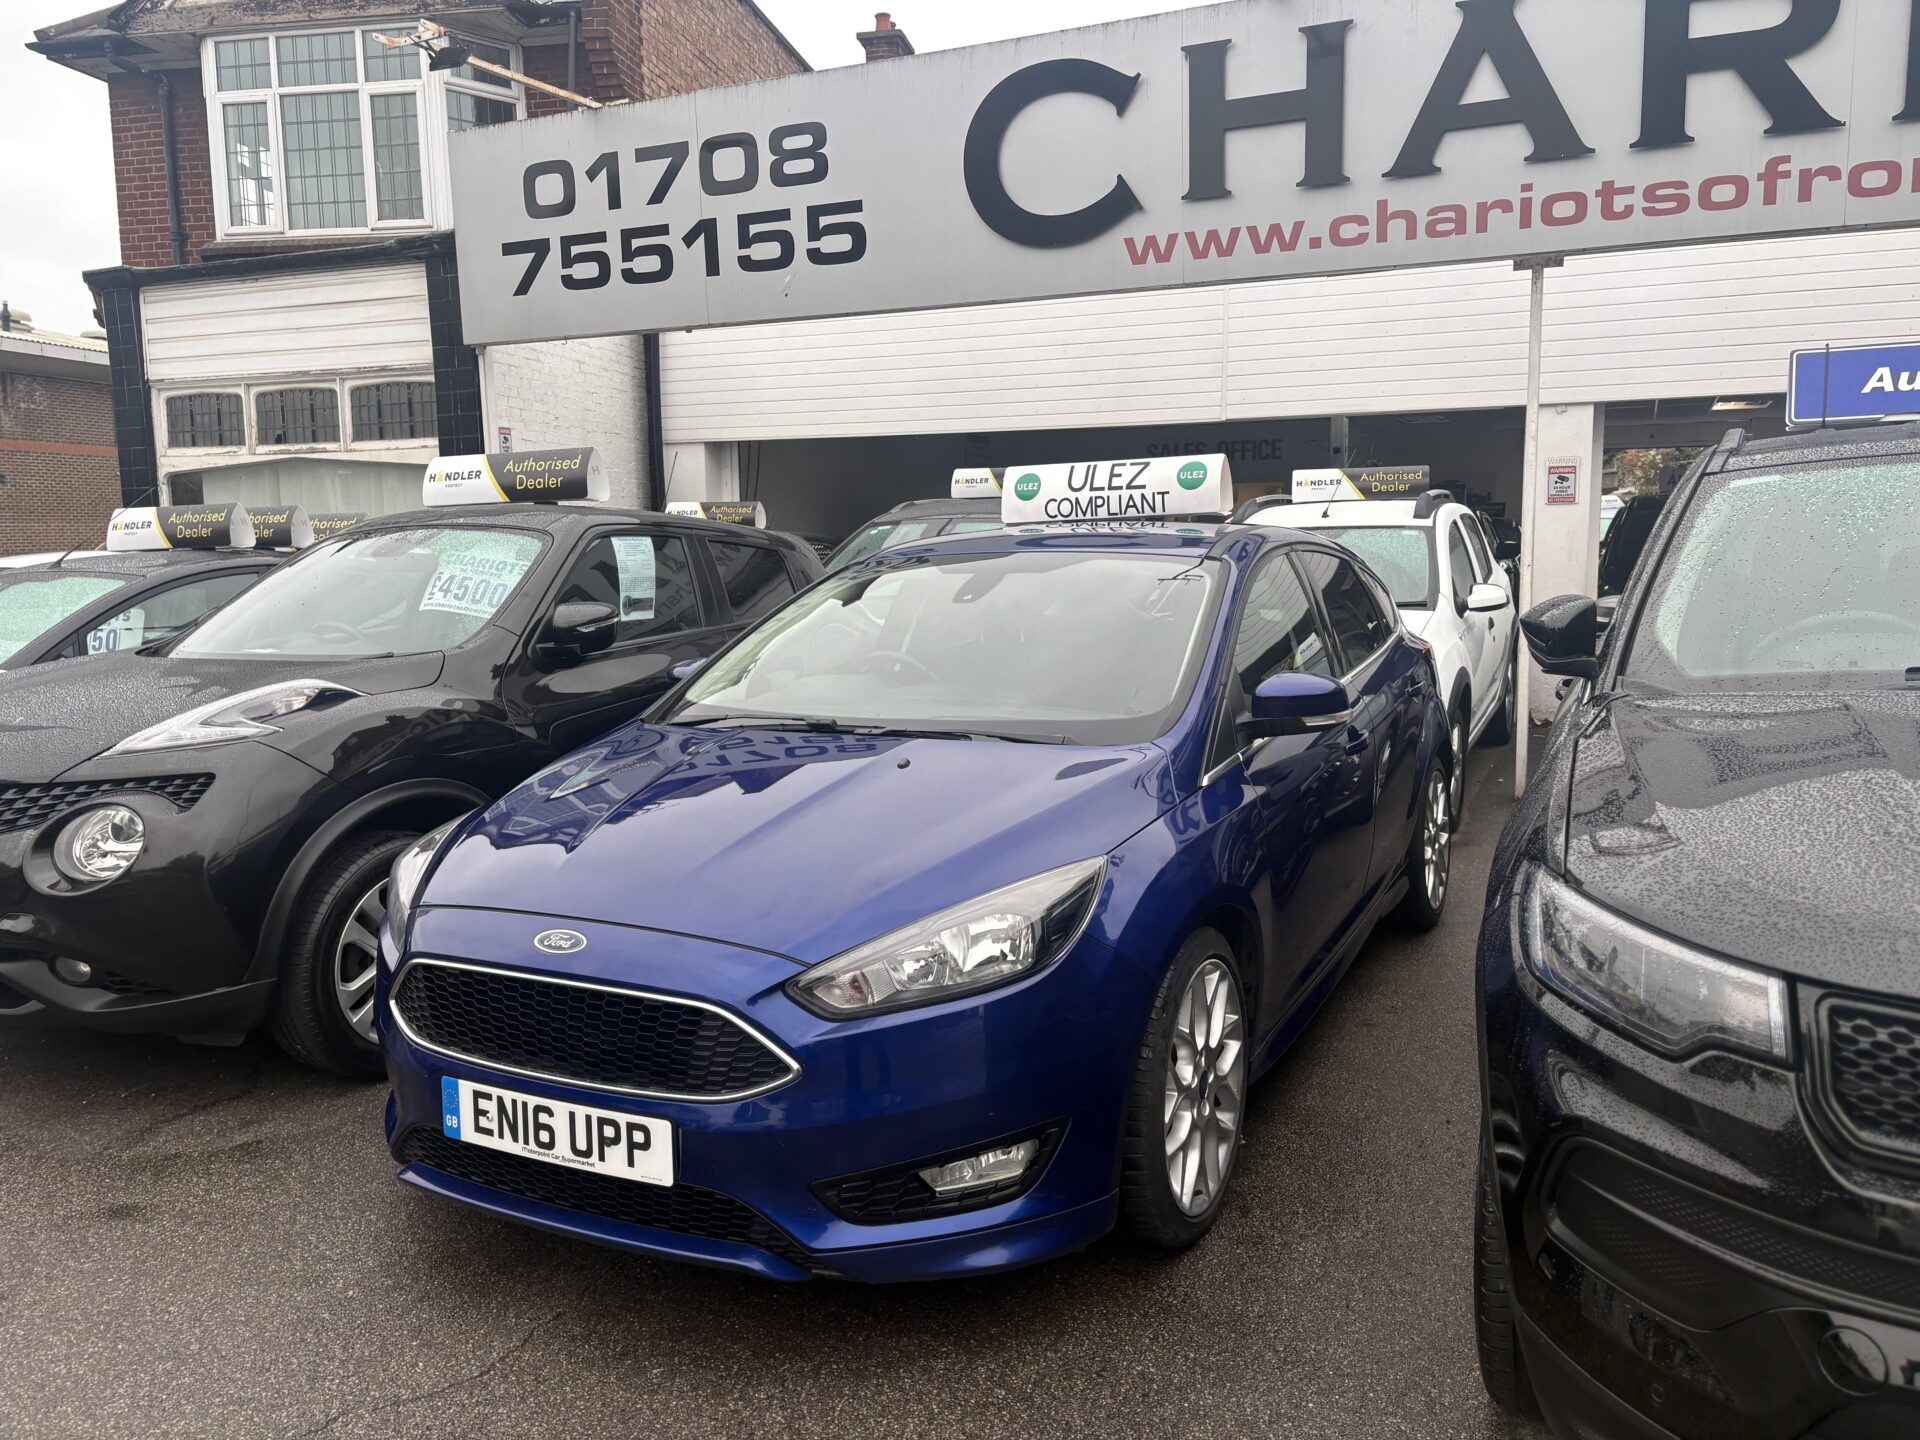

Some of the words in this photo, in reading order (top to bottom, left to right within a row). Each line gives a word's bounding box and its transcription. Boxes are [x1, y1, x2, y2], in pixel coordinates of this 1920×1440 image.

[963, 0, 1920, 249] CHAR
[522, 121, 829, 219] 01708
[1123, 155, 1920, 266] www.chariotsofro
[501, 199, 867, 297] 755155
[1217, 438, 1282, 462] OFFICE
[503, 453, 582, 473] Authorised
[516, 473, 563, 490] Dealer
[1067, 462, 1150, 492] ULEZ
[1180, 471, 1205, 479] ULEZ
[1360, 470, 1422, 481] Authorised
[1017, 483, 1039, 491] ULEZ
[1371, 482, 1411, 492] Dealer
[710, 505, 752, 514] Authorised
[1044, 491, 1170, 519] COMPLIANT
[168, 508, 227, 524] Authorised
[249, 511, 288, 524] horised
[716, 514, 743, 523] Dealer
[177, 524, 212, 538] Dealer
[254, 525, 274, 537] aler
[543, 933, 576, 948] Ford
[445, 1114, 459, 1128] GB
[472, 1089, 556, 1152] EN16
[568, 1110, 652, 1169] UPP
[561, 1155, 596, 1168] Supermarket
